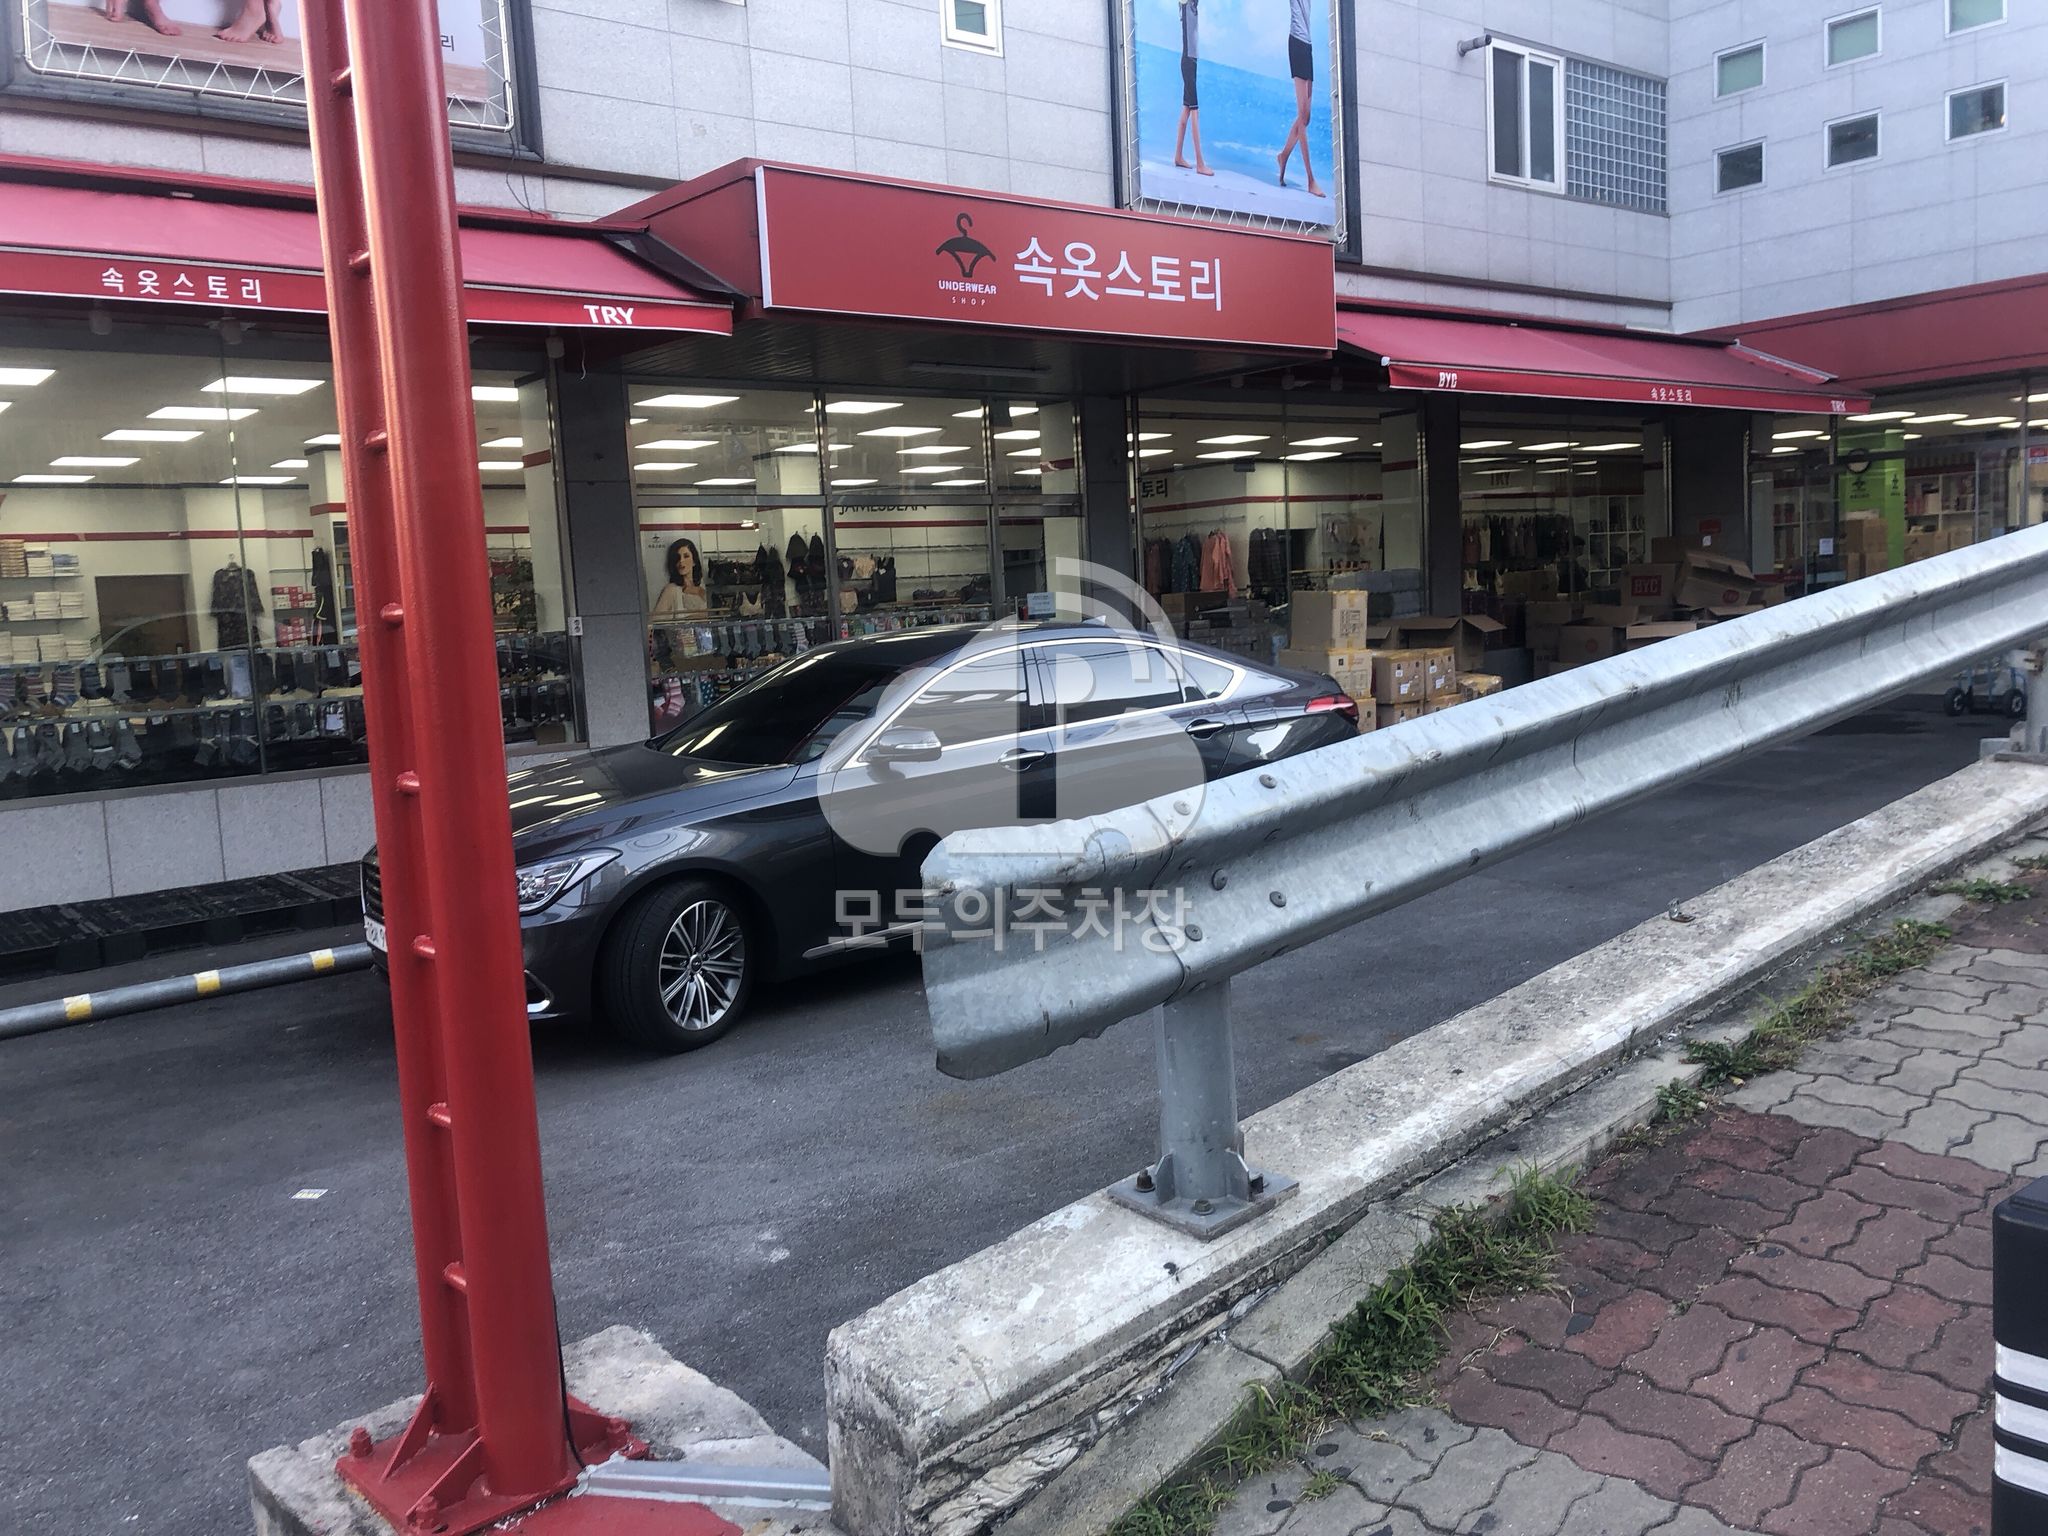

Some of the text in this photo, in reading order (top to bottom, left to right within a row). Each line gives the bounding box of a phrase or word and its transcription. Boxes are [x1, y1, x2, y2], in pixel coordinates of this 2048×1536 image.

[1014, 236, 1222, 311] 속옷스토리
[101, 267, 262, 303] 속옷스토리
[938, 280, 997, 295] UNDERWEAR
[952, 296, 986, 306] SHOP
[583, 304, 634, 325] TRY
[1438, 371, 1458, 389] BYC
[1650, 387, 1692, 403] 속옷스토리
